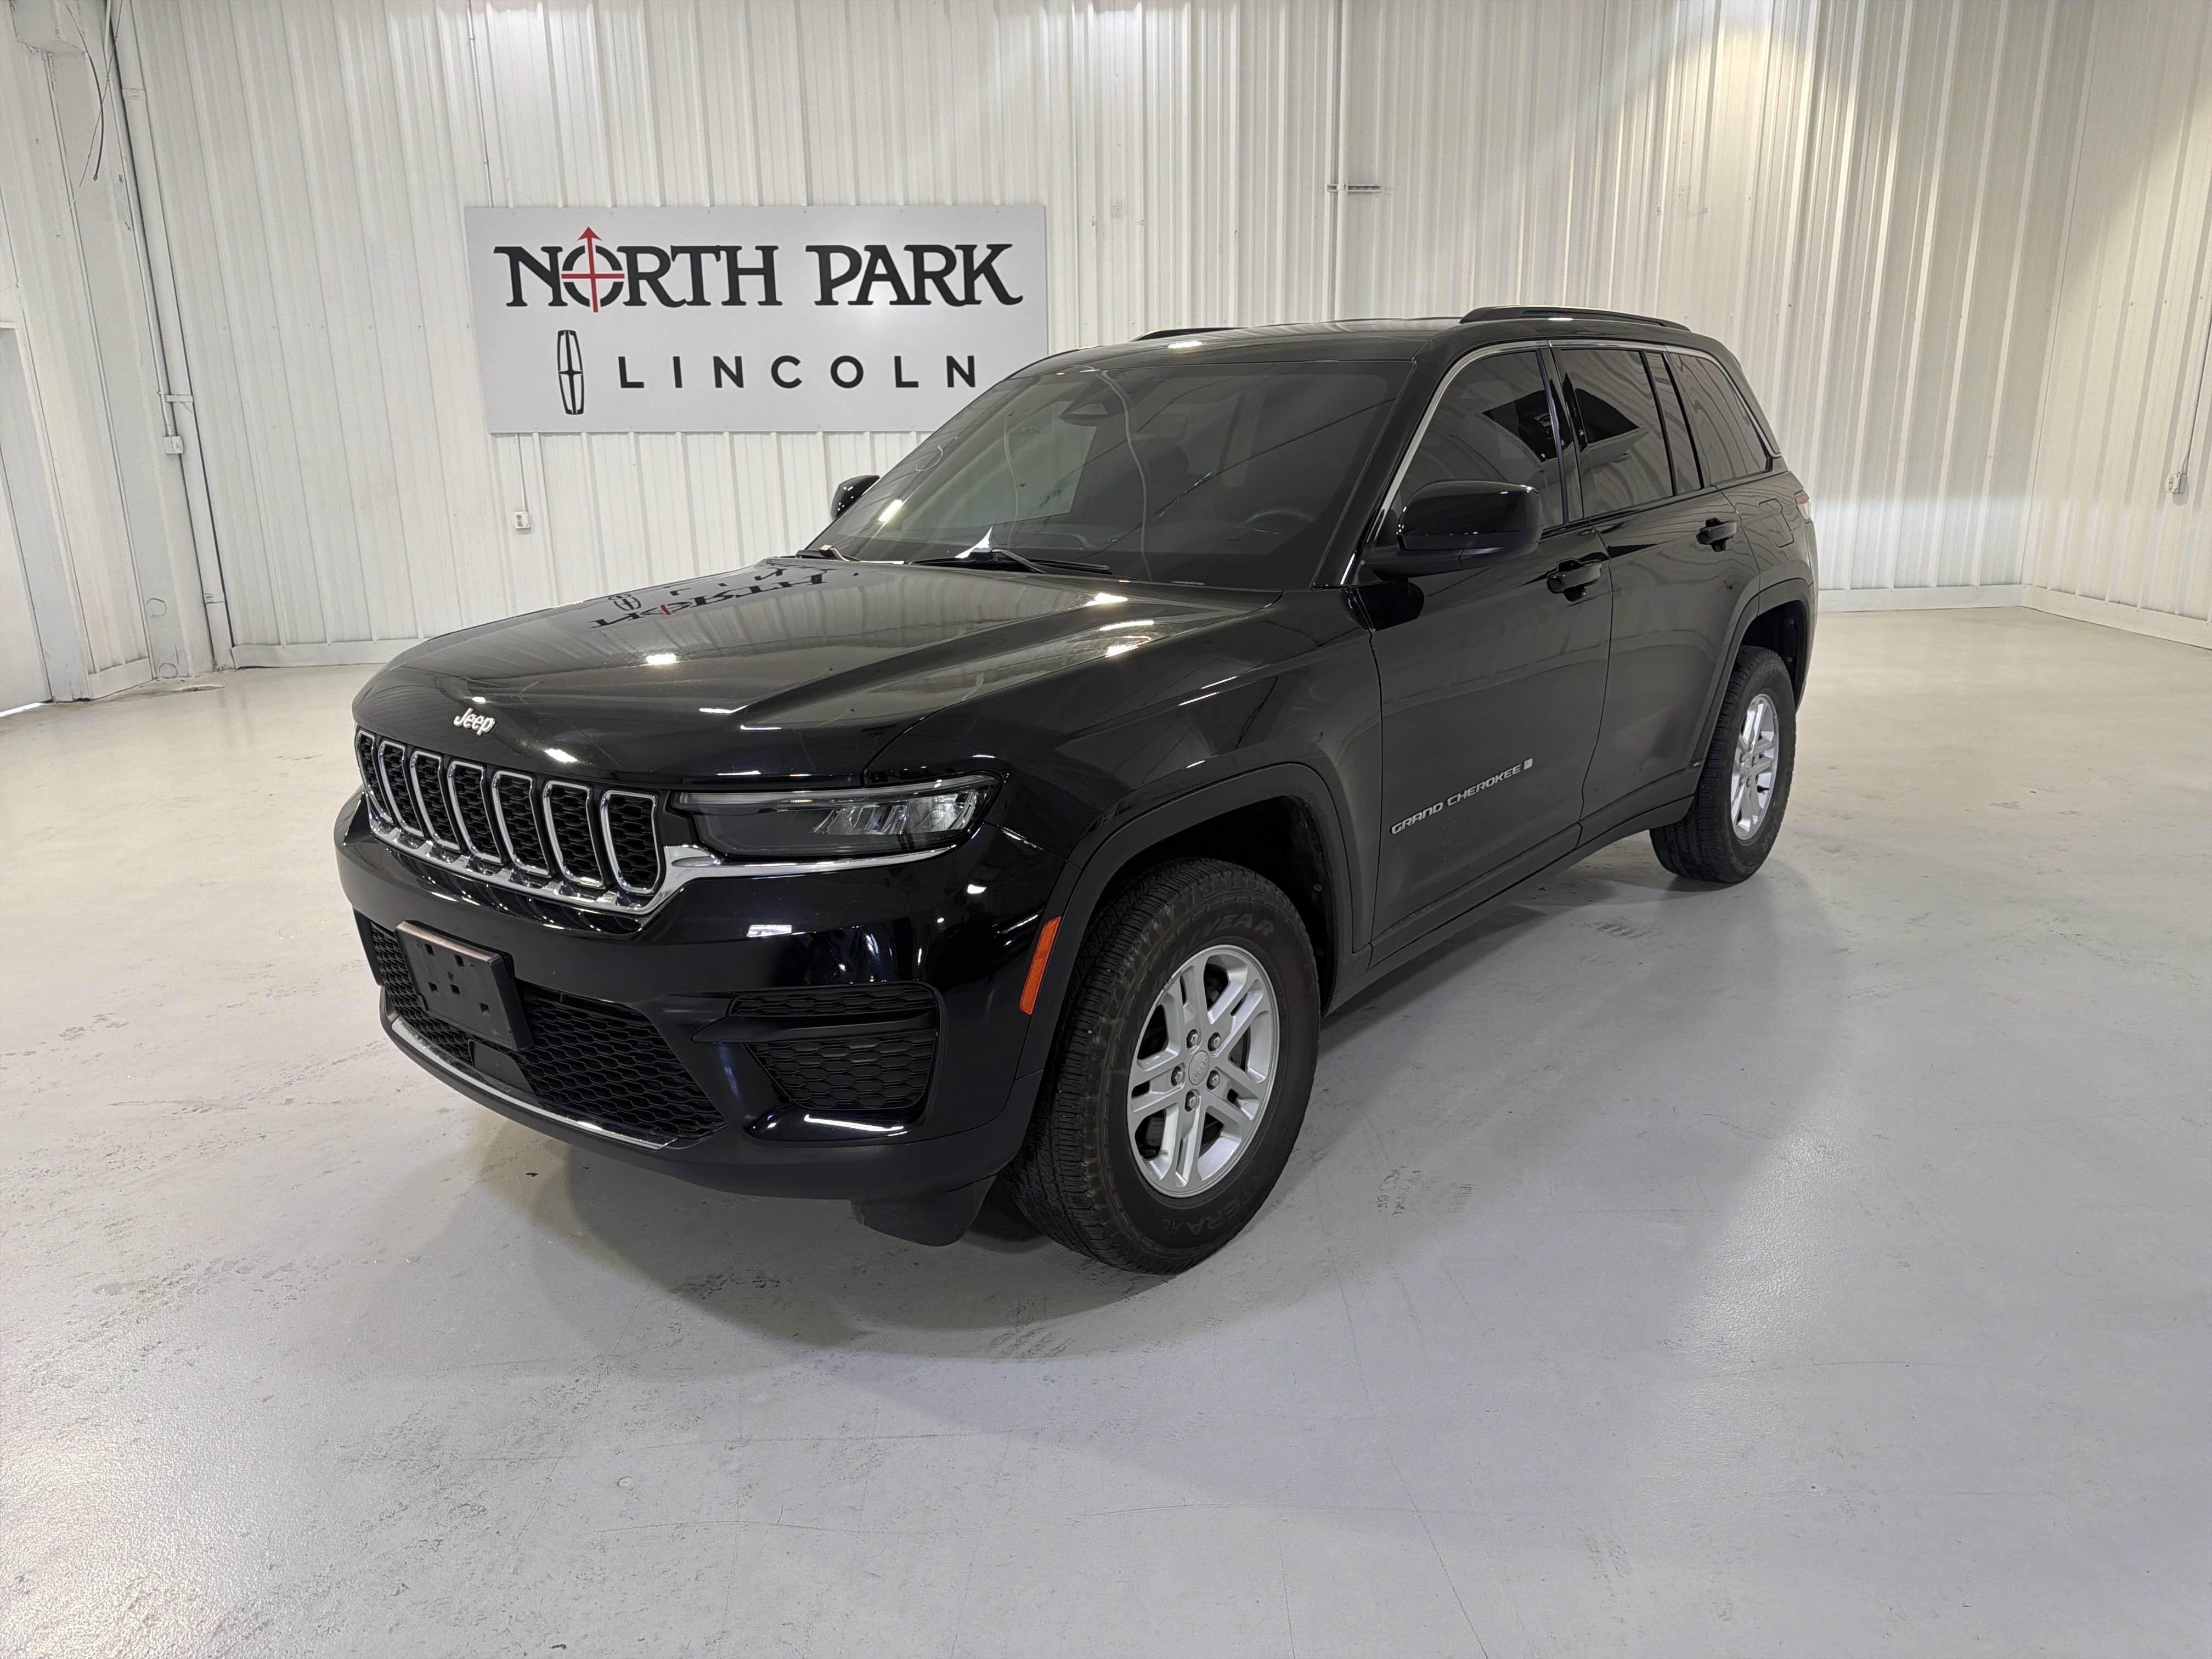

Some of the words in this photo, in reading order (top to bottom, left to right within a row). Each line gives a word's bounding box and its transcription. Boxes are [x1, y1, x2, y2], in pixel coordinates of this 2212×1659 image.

[493, 245, 783, 308] NORTH
[805, 244, 1024, 307] PARK
[618, 355, 976, 389] LINCOLN
[454, 708, 495, 736] Jeep
[1391, 802, 1443, 834] GRAND
[1447, 764, 1521, 806] CHEROKEE
